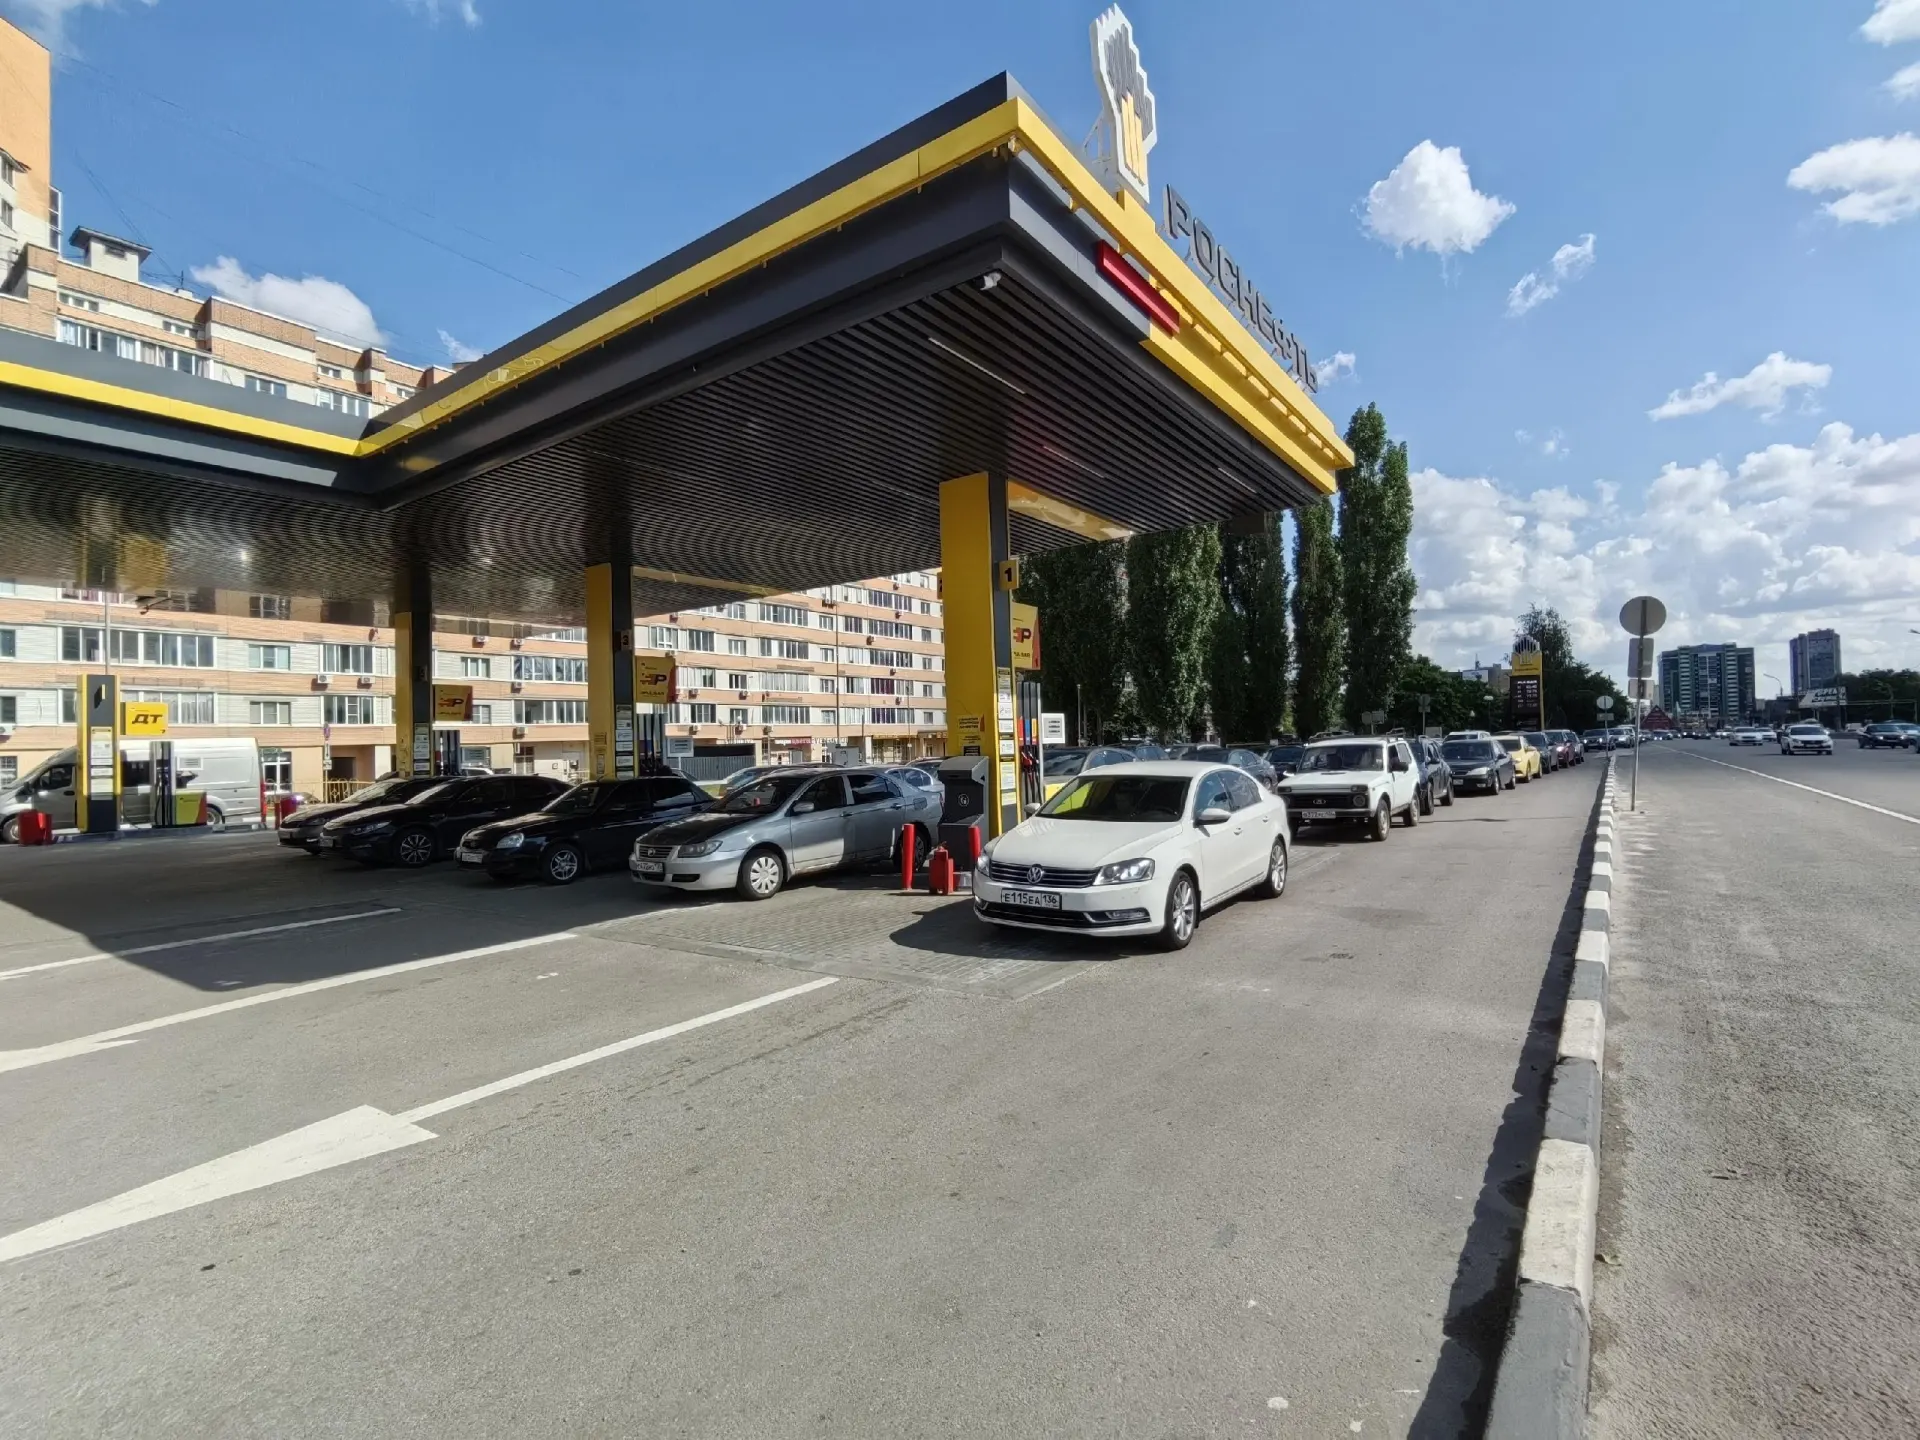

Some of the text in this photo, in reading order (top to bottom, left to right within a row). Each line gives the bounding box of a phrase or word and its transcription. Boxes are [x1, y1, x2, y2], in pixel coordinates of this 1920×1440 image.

[1163, 183, 1317, 394] РОСНЕФТЬ
[1004, 567, 1012, 582] 1
[622, 634, 629, 646] 3
[132, 713, 163, 725] ДТ
[1004, 892, 1058, 906] Е115ЕА 136
